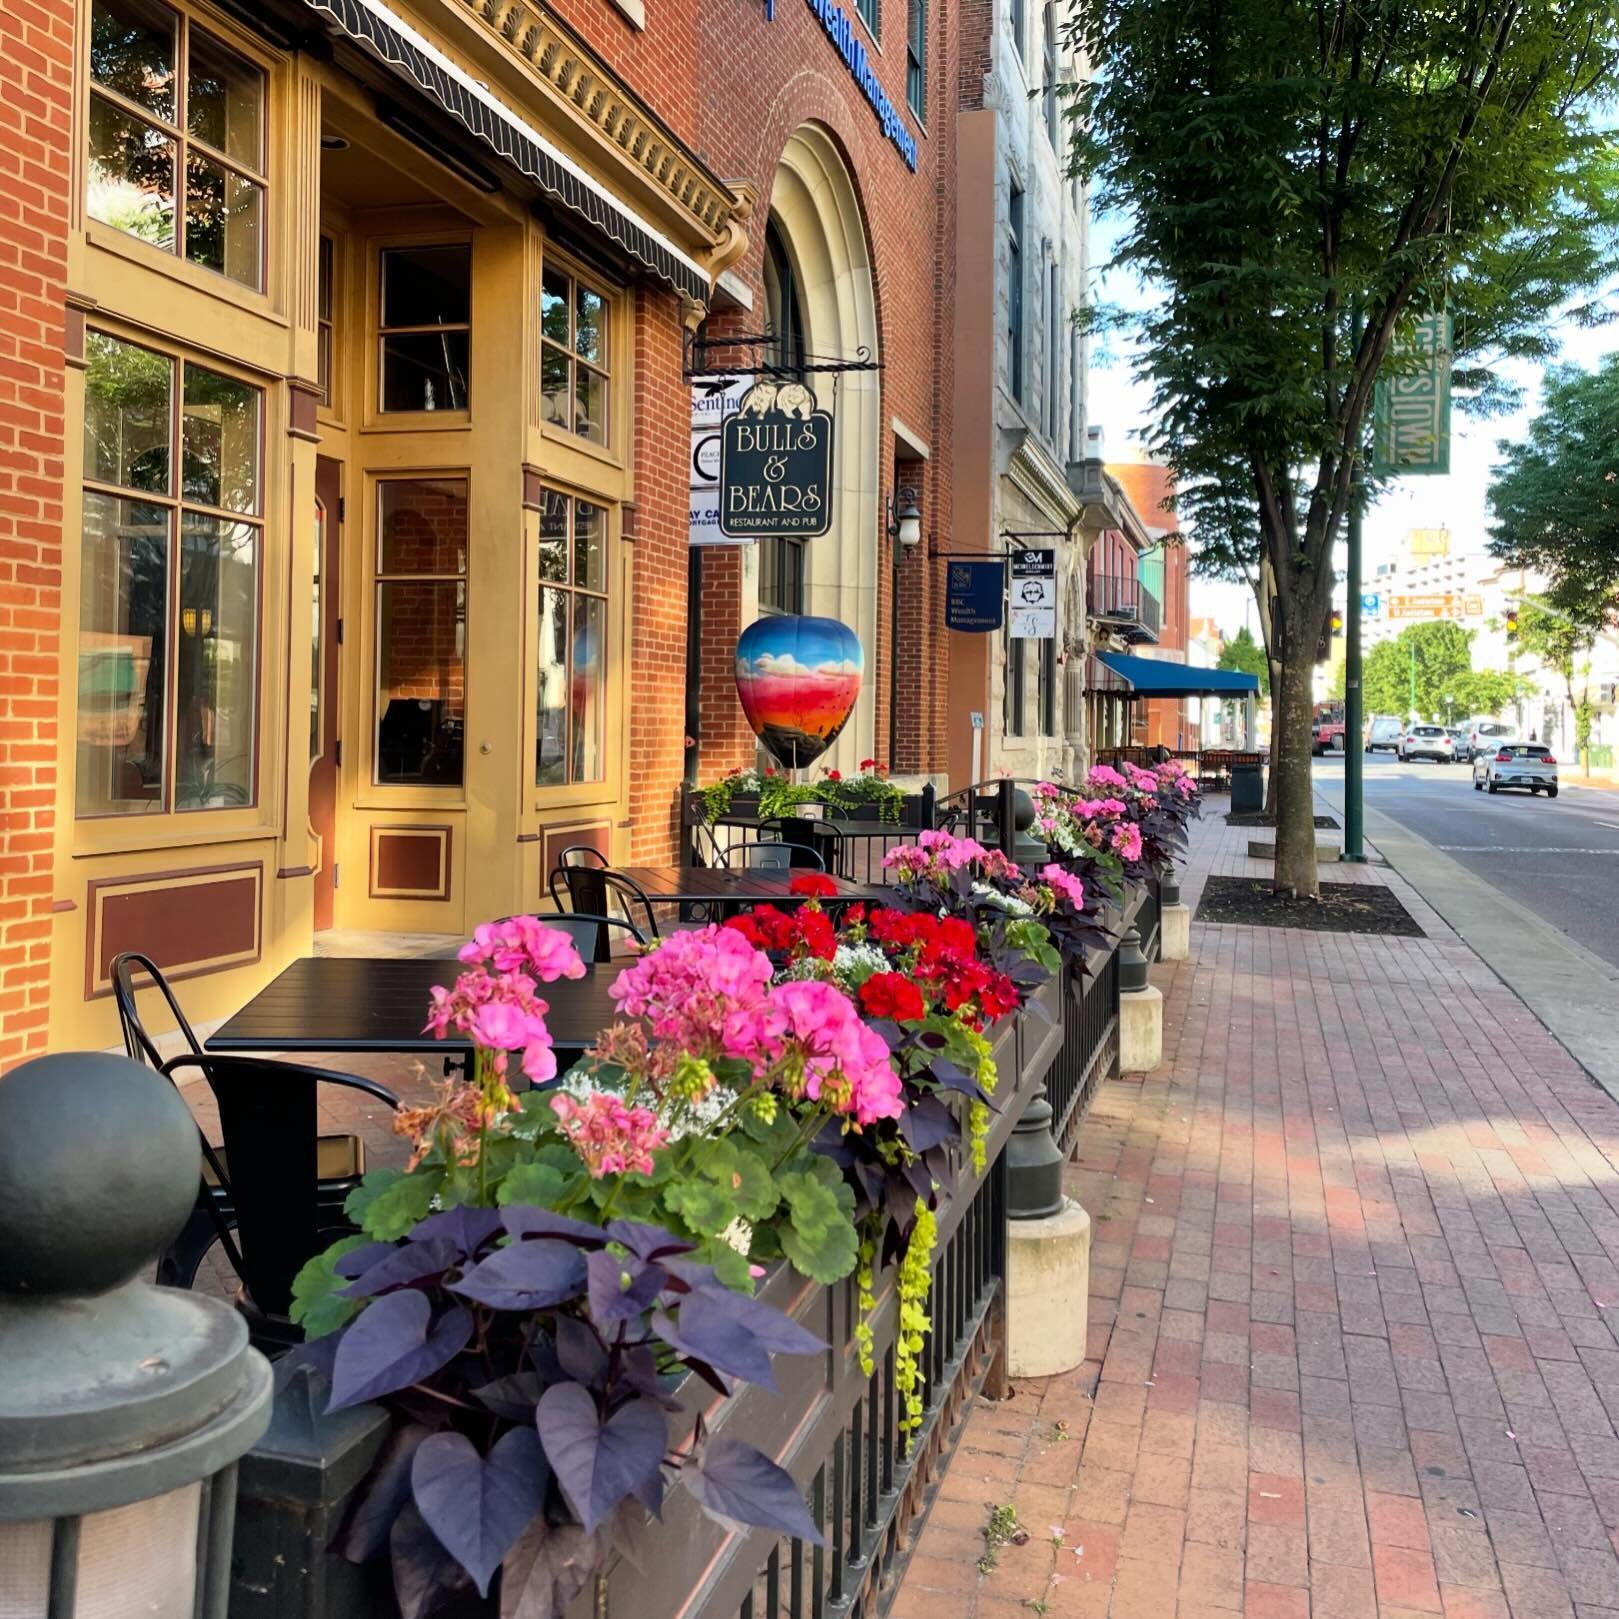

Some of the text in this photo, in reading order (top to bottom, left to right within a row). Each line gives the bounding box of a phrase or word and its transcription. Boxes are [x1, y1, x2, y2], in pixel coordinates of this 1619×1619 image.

[854, 40, 918, 173] Management
[736, 422, 817, 452] BULLS
[763, 455, 789, 482] &
[729, 484, 821, 512] BEARS
[729, 517, 817, 527] RESTAURANT AND PUB
[951, 608, 976, 616] Wealth
[951, 616, 996, 626] Management
